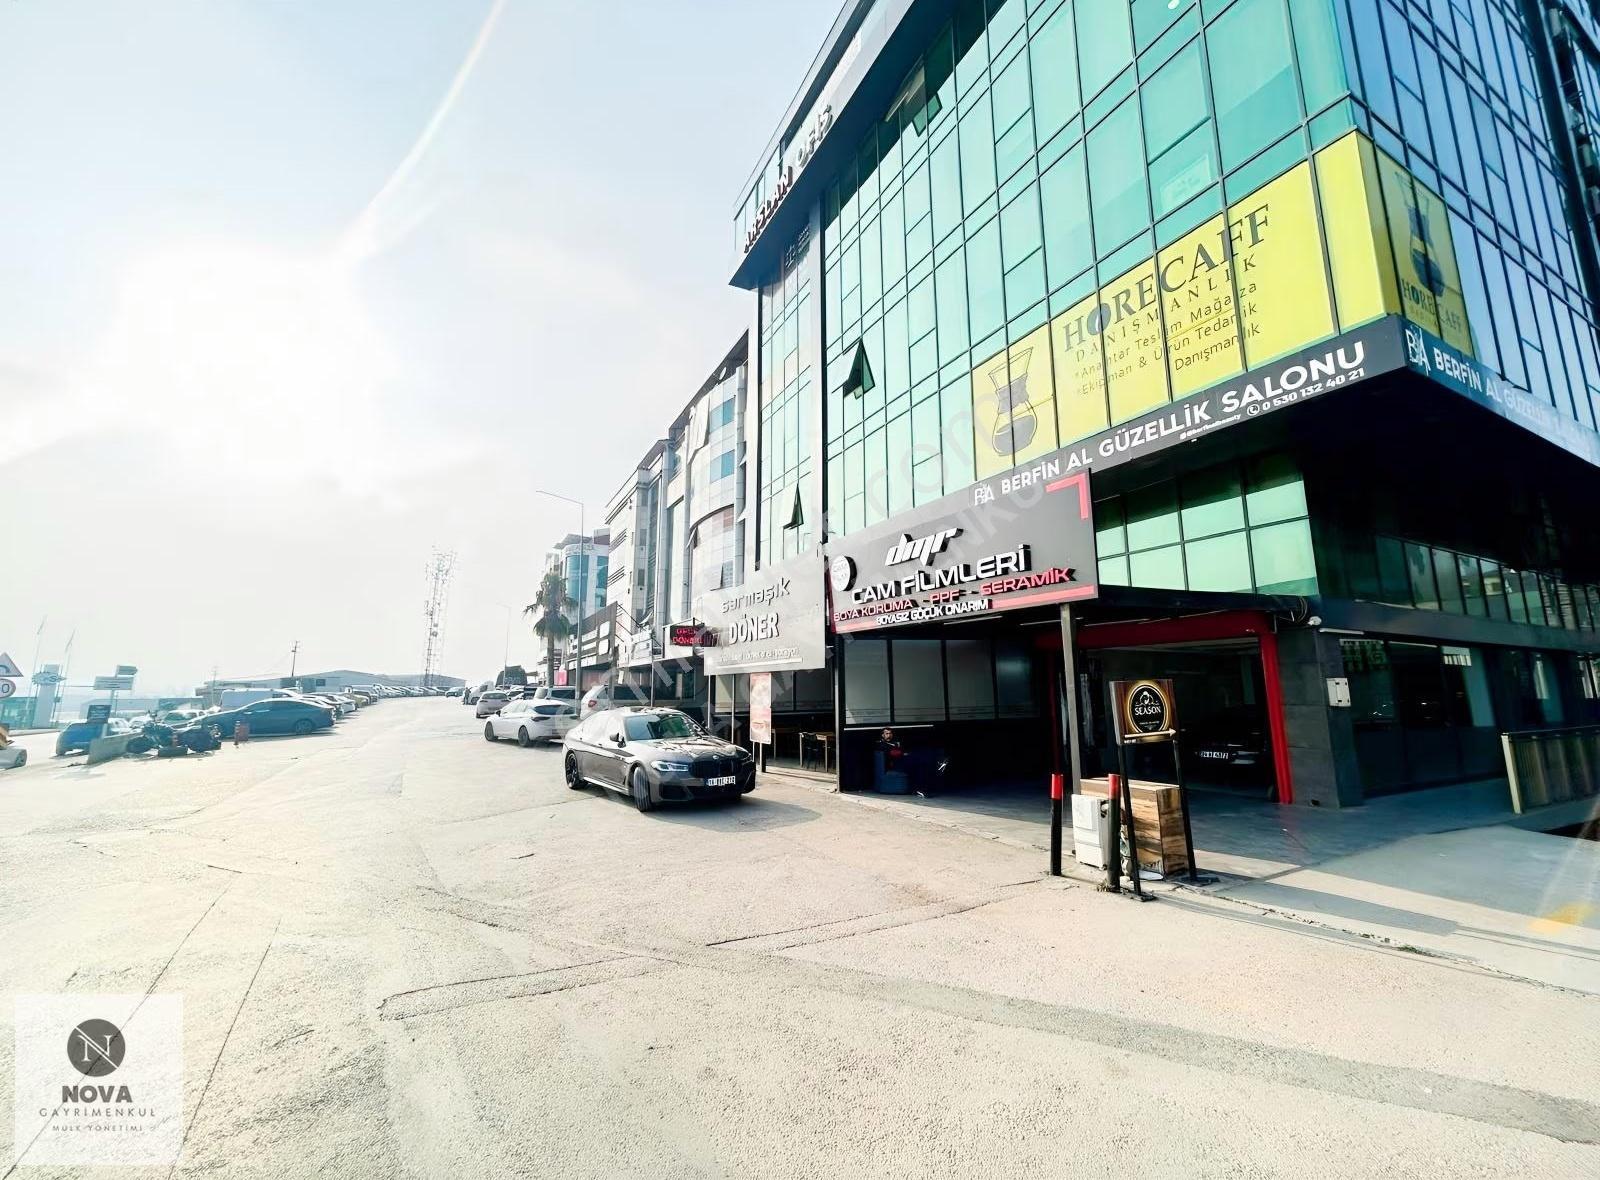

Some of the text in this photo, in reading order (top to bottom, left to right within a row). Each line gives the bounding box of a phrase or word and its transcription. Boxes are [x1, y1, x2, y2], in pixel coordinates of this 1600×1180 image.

[1062, 203, 1269, 353] HORECAFF
[1190, 281, 1257, 323] Mağaza
[1195, 301, 1258, 340] Tedarik
[1348, 367, 1365, 381] 21
[1433, 346, 1483, 393] BERFİN
[1486, 376, 1503, 403] AL
[1001, 458, 1060, 496] BERFİN
[1066, 448, 1093, 472] AL
[1098, 400, 1212, 457] GÜZELLİK
[1221, 340, 1366, 414] SALONU
[833, 608, 860, 622] BOYA
[860, 599, 914, 618] KORUMA
[929, 588, 960, 604] PPF
[981, 567, 1071, 597] SERAMİK
[851, 543, 1028, 605] CAM FİLMLERİ
[728, 612, 780, 646] DÖNER
[910, 604, 944, 621] GÖÇÜK
[945, 598, 989, 615] ONARIM
[1134, 704, 1162, 716] SEASON
